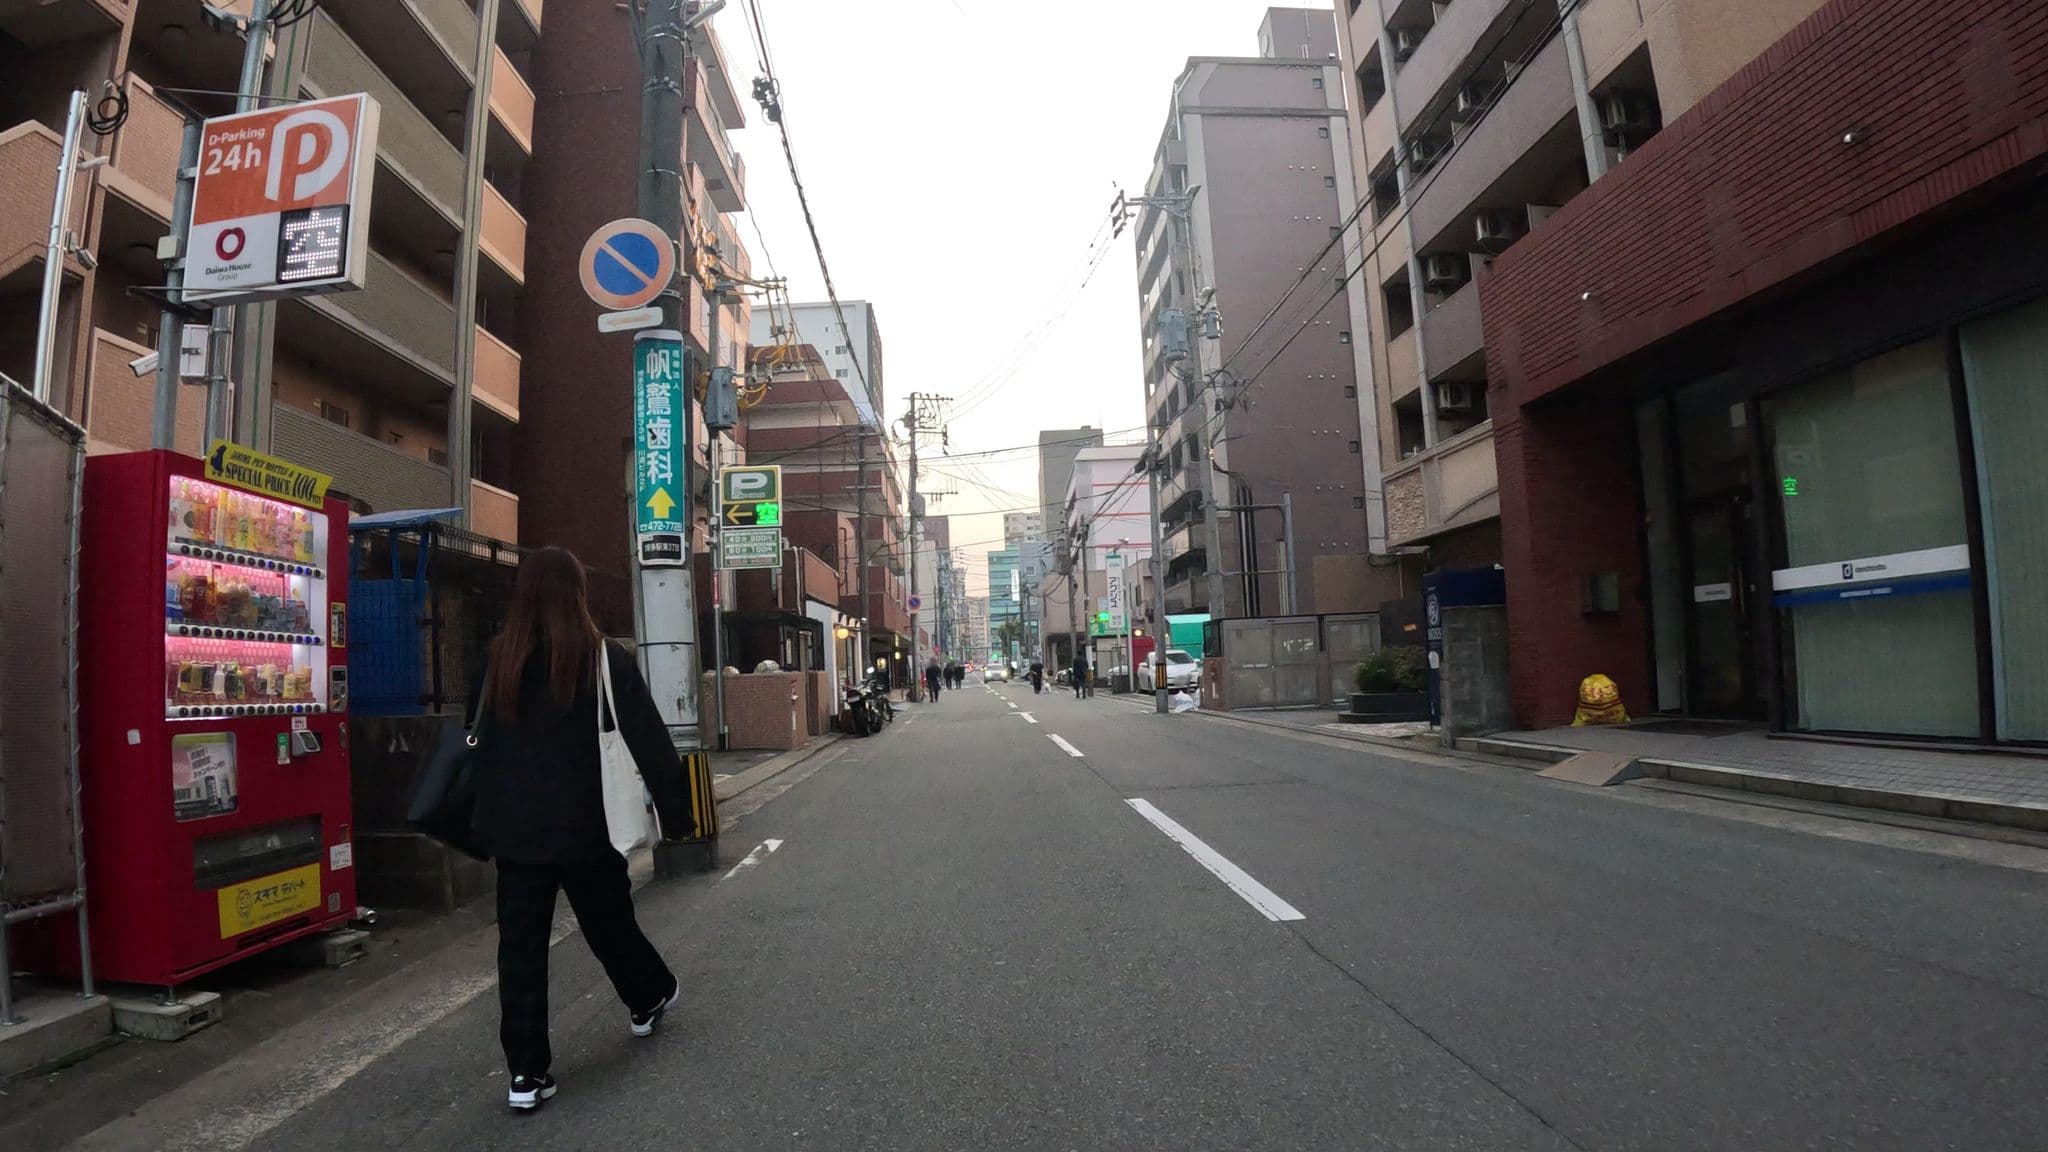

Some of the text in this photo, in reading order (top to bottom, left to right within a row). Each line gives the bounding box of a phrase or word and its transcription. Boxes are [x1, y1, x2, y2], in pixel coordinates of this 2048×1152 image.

[208, 127, 266, 146] D-Parking
[204, 142, 262, 176] 24h
[264, 109, 349, 201] P
[281, 211, 341, 281] 空
[205, 263, 251, 275] Daiwa House
[217, 273, 238, 281] Group
[225, 462, 317, 500] SPECIAL PRICE 100
[731, 472, 768, 500] P
